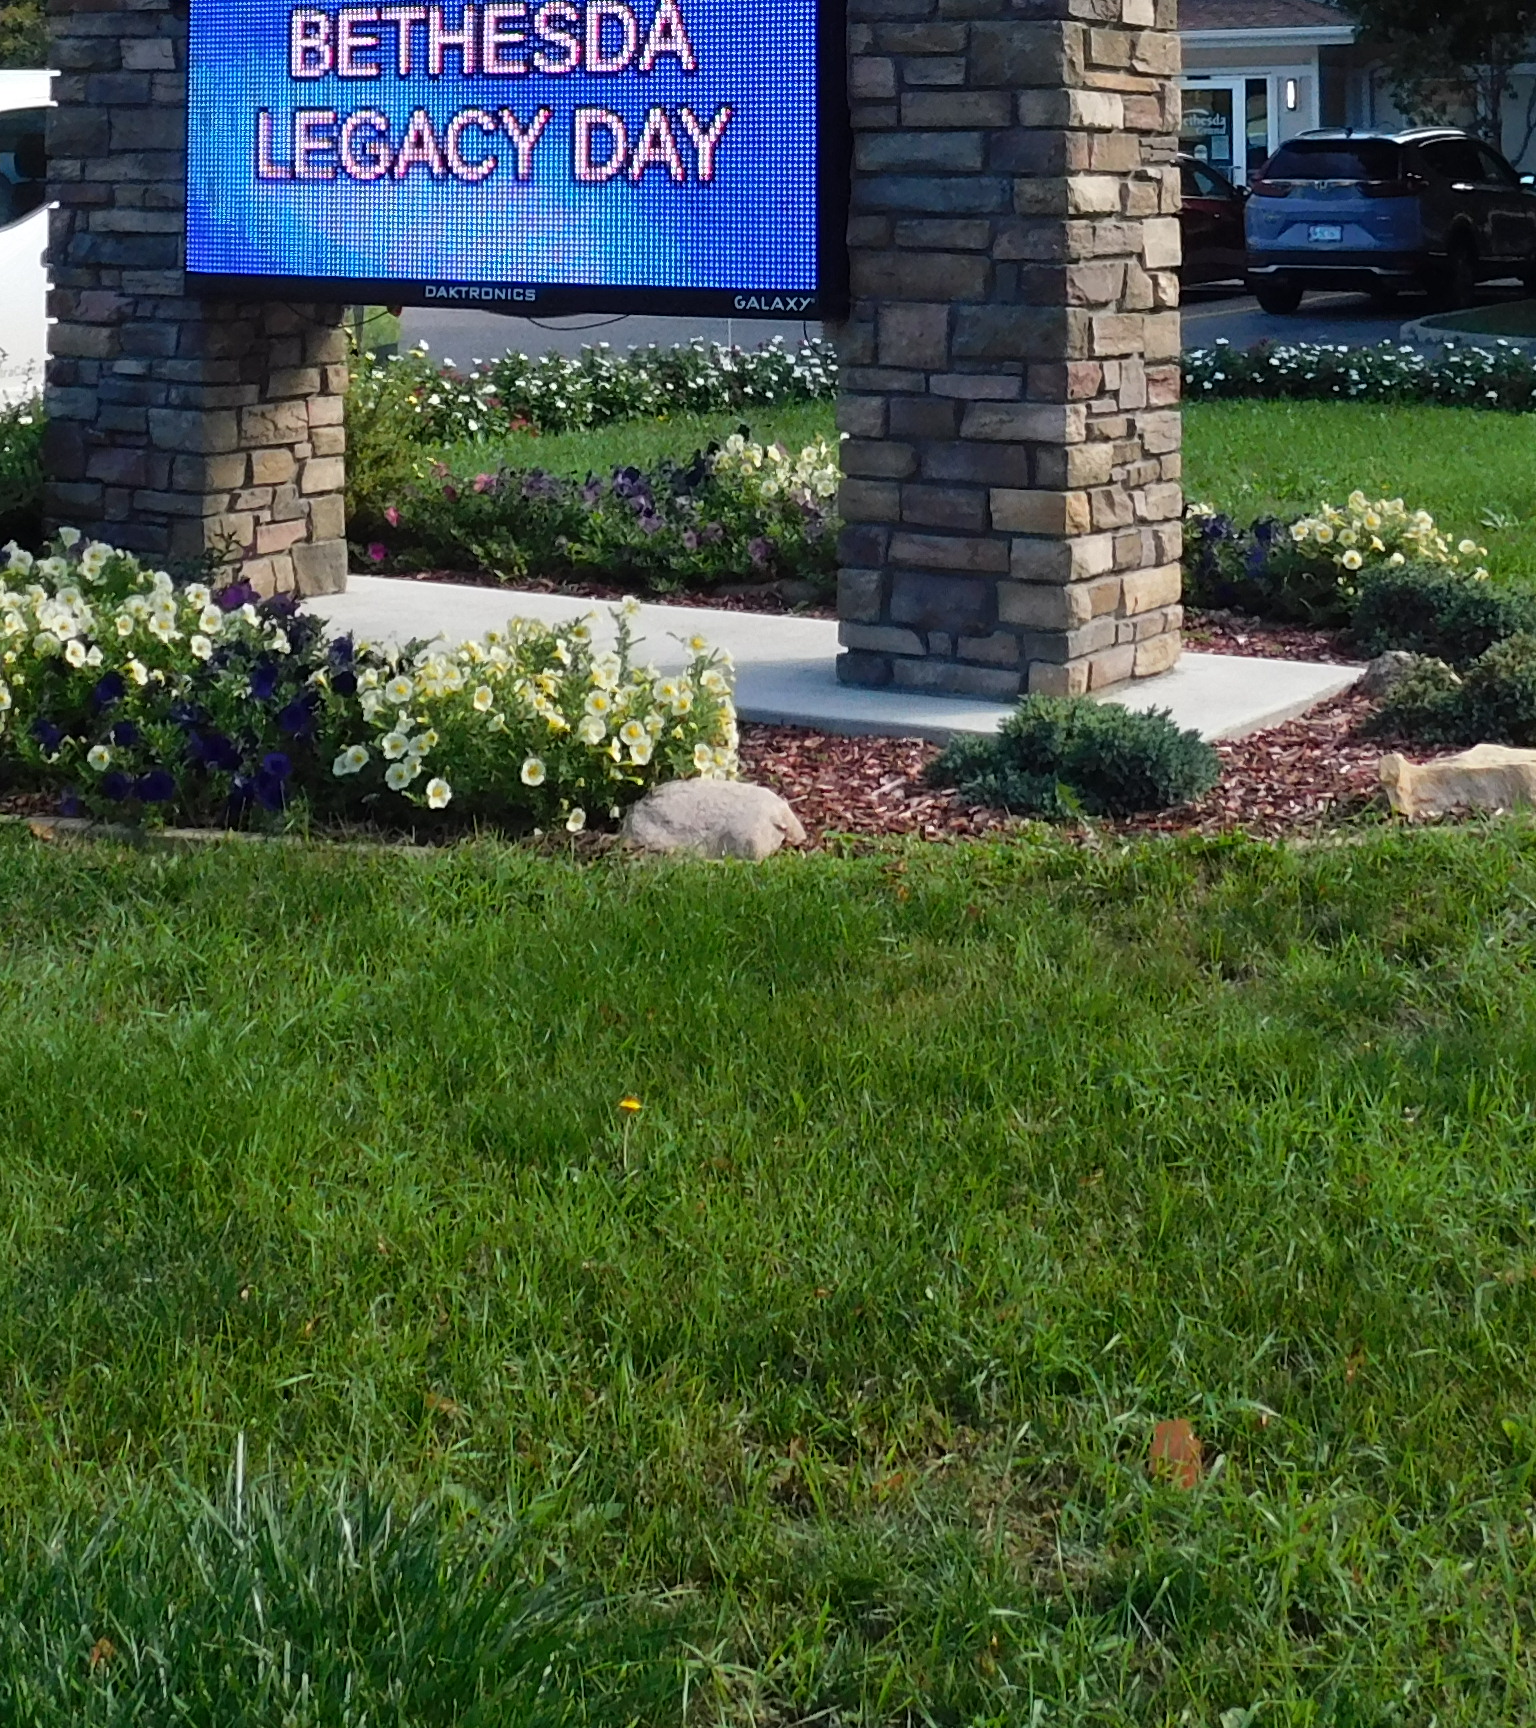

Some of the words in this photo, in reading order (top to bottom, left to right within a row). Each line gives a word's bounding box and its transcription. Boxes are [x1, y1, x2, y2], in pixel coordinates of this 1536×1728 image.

[1182, 112, 1226, 126] ethesda
[257, 106, 551, 182] LEGACY
[573, 105, 734, 184] DAY
[425, 285, 536, 301] DAKTRONICS
[734, 295, 811, 312] GALAXY
